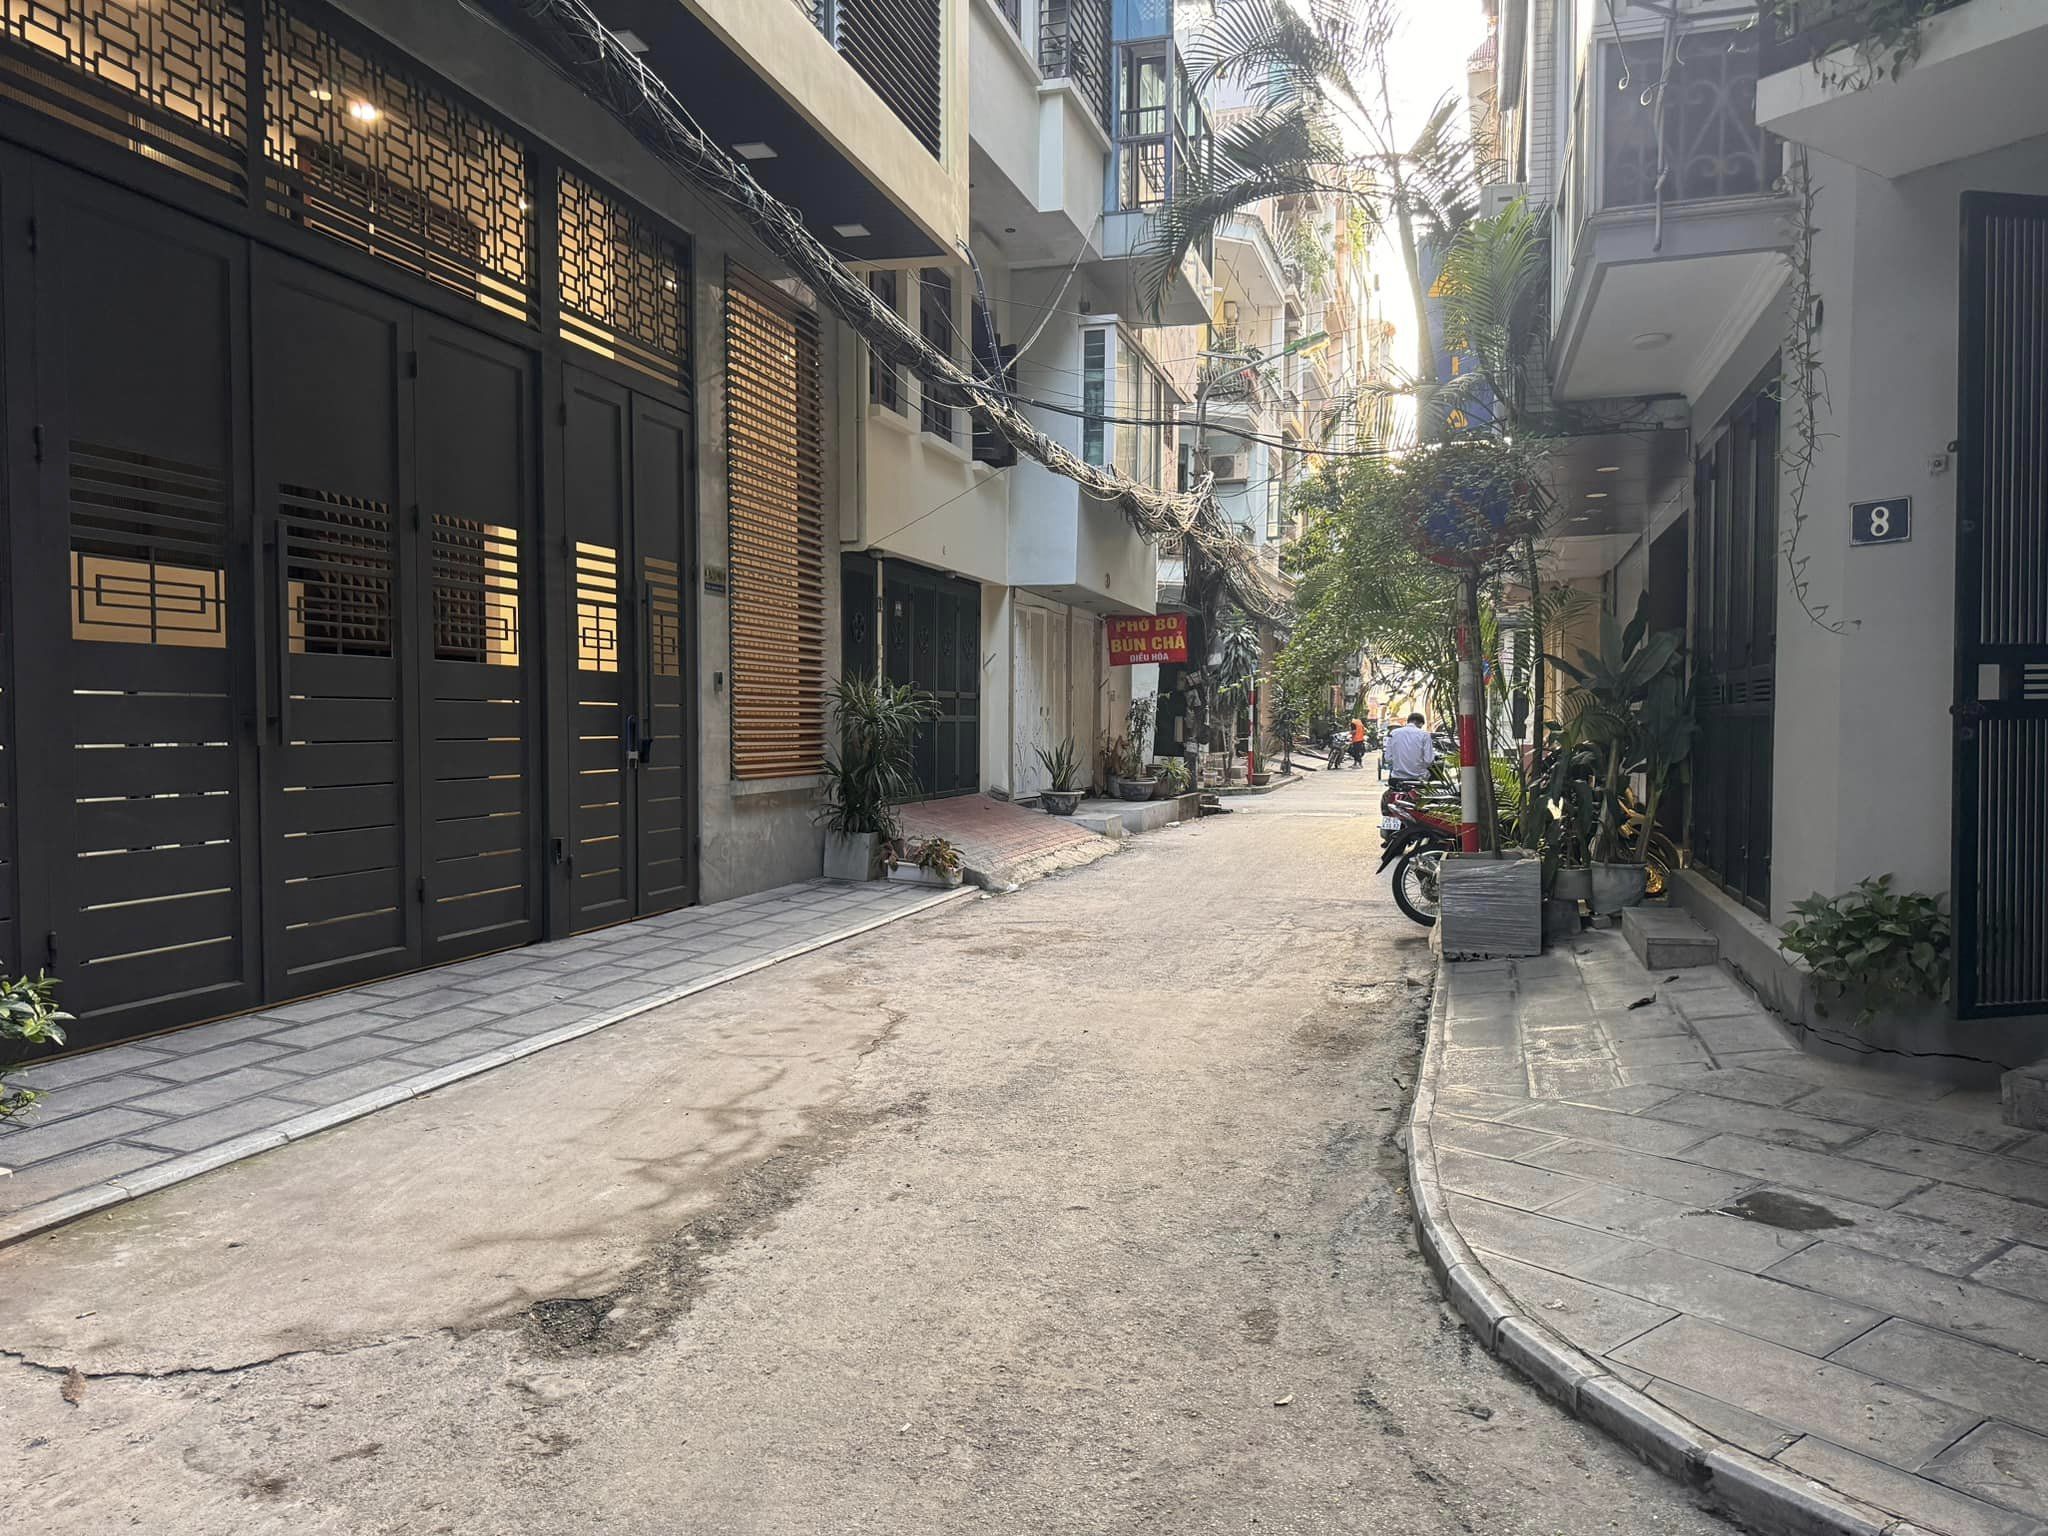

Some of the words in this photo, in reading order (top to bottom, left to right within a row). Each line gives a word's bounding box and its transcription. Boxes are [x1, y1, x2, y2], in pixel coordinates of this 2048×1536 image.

[1871, 506, 1889, 537] 8
[1111, 636, 1146, 653] BÚN
[1152, 631, 1185, 650] CHẢ
